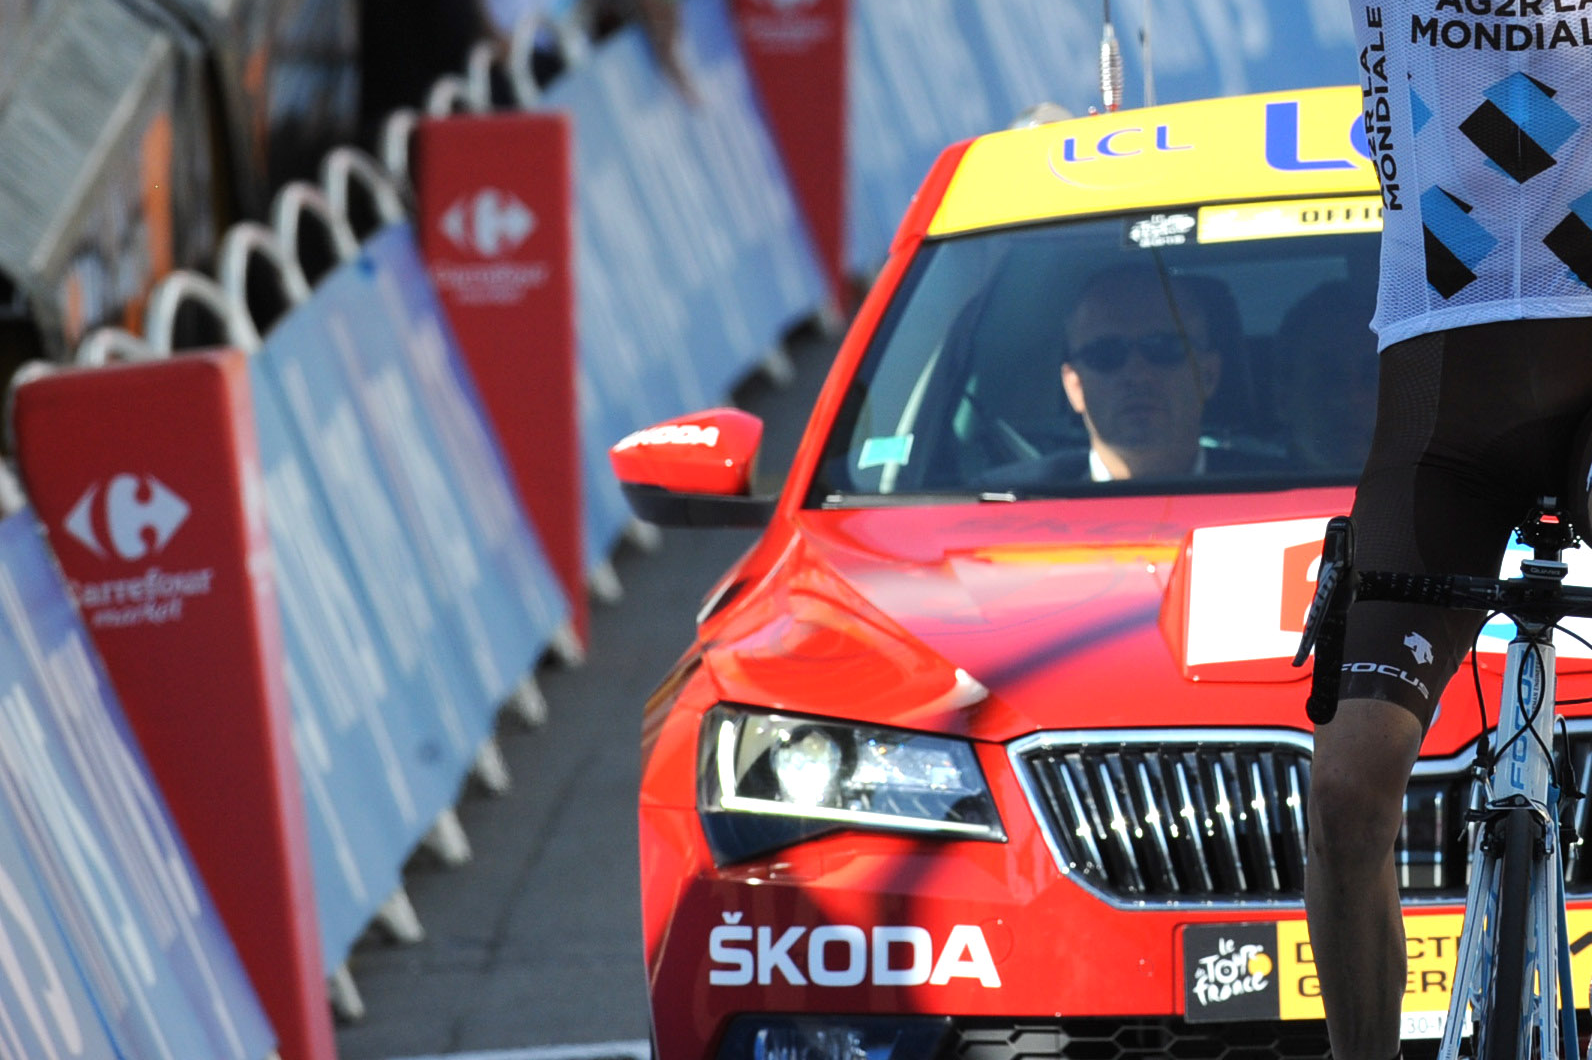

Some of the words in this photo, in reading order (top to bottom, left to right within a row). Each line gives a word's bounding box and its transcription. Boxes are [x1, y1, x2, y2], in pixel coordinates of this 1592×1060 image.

[1063, 125, 1194, 163] LCL
[1366, 5, 1403, 211] MONDIALE
[1341, 662, 1430, 700] FOCUS
[1510, 649, 1536, 791] FOCUS
[709, 911, 1002, 988] ŠKODA
